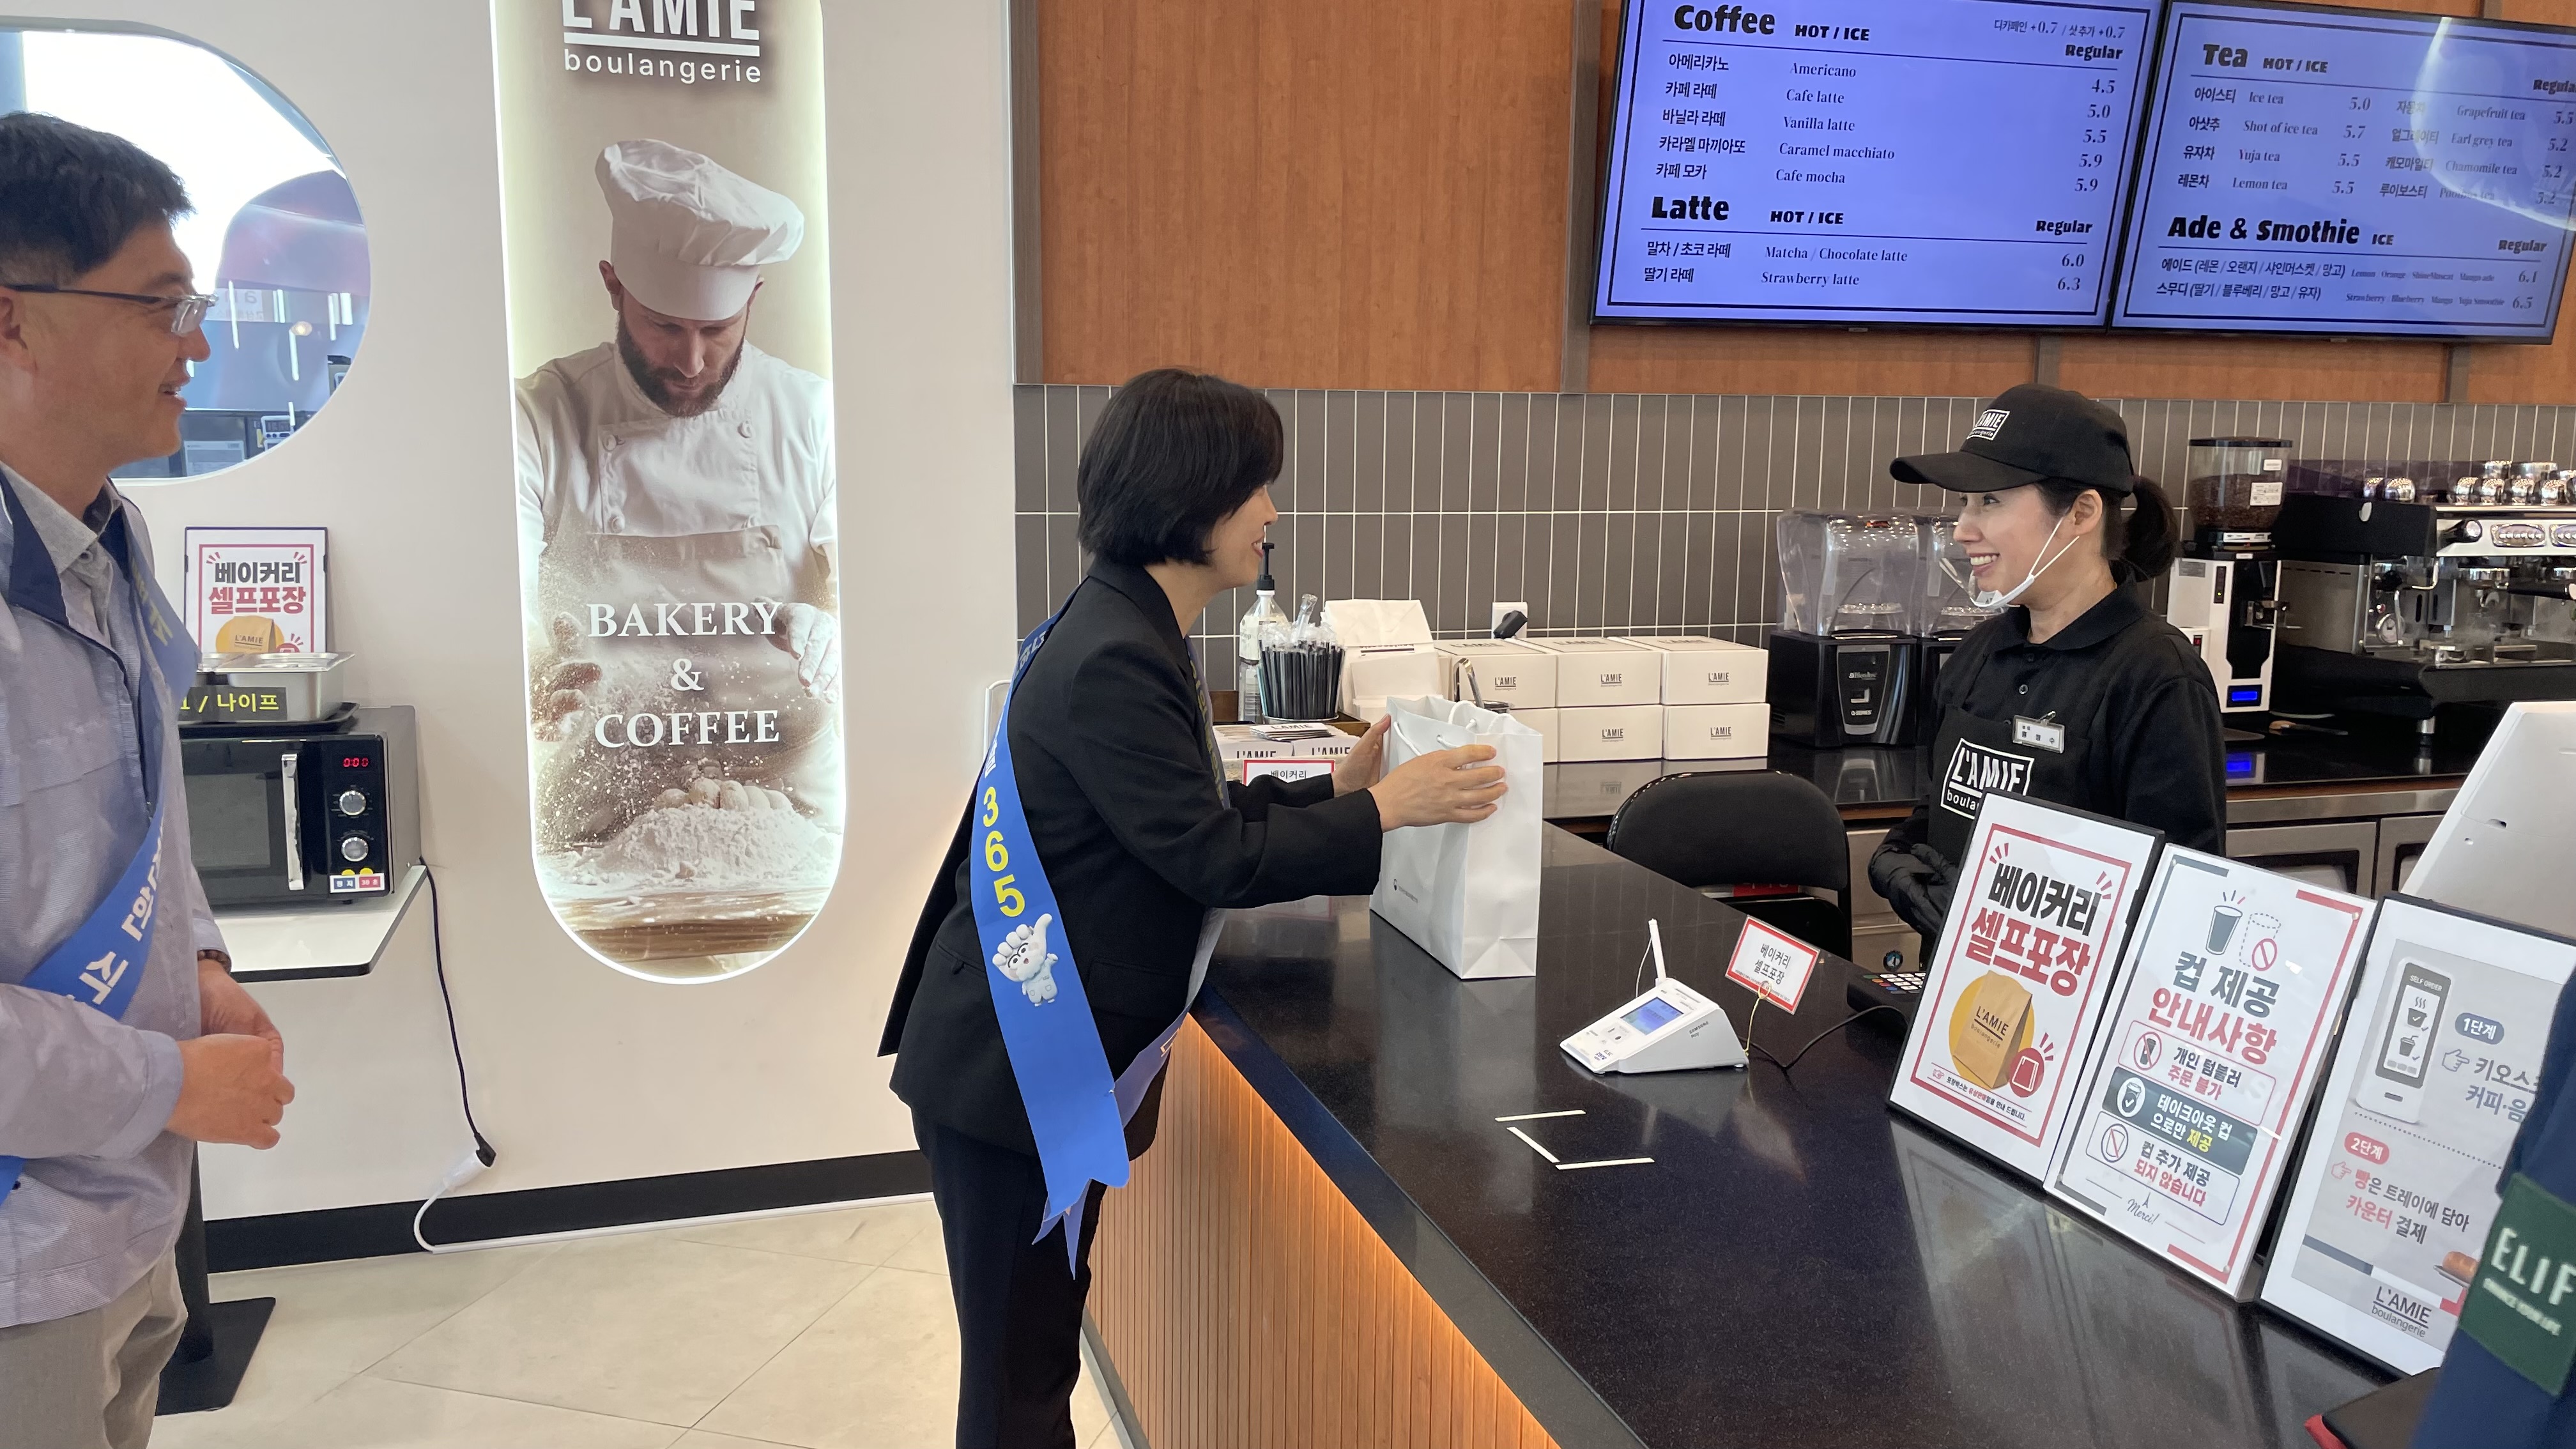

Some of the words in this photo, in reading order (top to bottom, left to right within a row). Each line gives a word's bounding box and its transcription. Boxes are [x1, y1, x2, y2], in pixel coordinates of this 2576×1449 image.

[1674, 4, 1775, 34] Coffee
[1994, 19, 2028, 33] 디카페인
[1795, 24, 1829, 38] HOT
[1844, 28, 1870, 41] ICE
[2066, 44, 2123, 61] Regular
[2203, 44, 2248, 68] Tea
[564, 49, 761, 84] boulangerie
[1669, 54, 1729, 72] 아메리카노
[1790, 63, 1856, 77] Americano
[2263, 57, 2294, 69] HOT
[2305, 61, 2328, 73] ICE
[1666, 82, 1690, 98] 카페
[1694, 84, 1717, 99] 라떼
[2092, 79, 2115, 93] 4.5
[1786, 89, 1814, 103] Cafe
[1817, 90, 1844, 103] latte
[2195, 87, 2236, 103] 아이스티
[2249, 92, 2265, 102] Ice
[2267, 93, 2284, 104] tea
[2087, 104, 2111, 118] 5.0
[2349, 96, 2370, 111] 5.0
[1662, 109, 1699, 125] 바닐라
[1701, 111, 1726, 126] 라떼
[2457, 105, 2508, 120] Grapefruit
[2511, 109, 2525, 120] tea
[2553, 111, 2573, 124] 5.5
[1784, 117, 1823, 130] Vanilla
[1828, 118, 1855, 131] latte
[2189, 116, 2220, 132] 아샷추
[2243, 121, 2267, 132] Shot
[2271, 122, 2282, 133] of
[2284, 123, 2299, 134] ice
[2303, 123, 2318, 135] tea
[2083, 130, 2106, 143] 5.5
[2343, 125, 2366, 139] 5.7
[1659, 137, 1695, 152] 카라멜
[1698, 139, 1745, 154] 마끼아또
[2451, 133, 2471, 144] Earl
[2498, 136, 2513, 147] tea
[2548, 138, 2568, 151] 5.2
[1779, 143, 1830, 157] Caramel
[1833, 147, 1894, 160] macchiato
[2184, 145, 2214, 160] 유자차
[2239, 150, 2261, 163] Yuja
[2264, 150, 2280, 162] tea
[2079, 154, 2102, 167] 5.9
[2338, 153, 2360, 166] 5.5
[1656, 164, 1680, 179] 카페
[1683, 164, 1707, 180] 모카
[2446, 161, 2500, 174] Chamomile
[2503, 164, 2517, 174] tea
[2542, 165, 2563, 178] 5.2
[1776, 169, 1802, 182] Cafe
[1805, 172, 1845, 183] mocha
[2178, 174, 2209, 188] 레몬차
[2075, 178, 2098, 192] 5.9
[2233, 178, 2269, 188] Lemon
[2272, 178, 2287, 190] tea
[2332, 181, 2355, 194] 5.5
[2380, 183, 2428, 198] 루이보스티
[1652, 195, 1729, 220] Latte
[1770, 211, 1804, 223] HOT
[1818, 212, 1844, 224] ICE
[2036, 220, 2092, 235] Regular
[2168, 215, 2221, 239] Ade
[2230, 218, 2247, 239] &
[2257, 218, 2359, 244] Smothie
[2372, 234, 2394, 245] ICE
[2498, 240, 2547, 254] Regular
[1647, 241, 1671, 257] 말차
[1680, 242, 1705, 256] 초코
[1707, 243, 1731, 258] 라떼
[1766, 247, 1807, 259] Matcha
[1820, 248, 1878, 261] Chocolate
[1881, 250, 1908, 262] latte
[2062, 254, 2084, 266] 6.0
[2162, 258, 2193, 273] 에이드
[1644, 267, 1667, 281] 딸기
[1671, 268, 1694, 282] 라떼
[1761, 272, 1829, 287] Strawberry
[1832, 273, 1860, 285] latte
[2518, 270, 2538, 283] 6.1
[2058, 277, 2080, 291] 6.3
[2156, 282, 2188, 296] 스무디
[2223, 284, 2264, 298] 블루베리
[2271, 286, 2289, 298] 망고
[2513, 296, 2533, 309] 6.5
[215, 562, 300, 583] 베이커리
[209, 586, 306, 615] 셀프포장
[586, 602, 783, 637] BAKERY
[235, 634, 263, 644] L'AMIE
[670, 658, 705, 691] &
[1495, 677, 1516, 686] L'AMIE
[1601, 673, 1621, 682] L'AMIE
[1708, 673, 1729, 681] L'AMIE
[217, 693, 279, 712] 나이프
[594, 710, 779, 748] COFFEE
[1602, 728, 1623, 737] L'AMIE
[1710, 726, 1731, 735] L'AMIE
[343, 758, 369, 767] 0:00
[1271, 770, 1307, 779] 베이커리
[983, 786, 1025, 917] 365
[1988, 862, 2102, 936] 베이커리
[1761, 944, 1791, 969] 베이커리
[1965, 907, 2091, 997] 셀프포장
[1754, 960, 1784, 985] 셀프포장
[2174, 951, 2207, 992] 컵
[2210, 965, 2280, 1018] 제공
[2410, 976, 2423, 984] SELF
[2424, 981, 2442, 991] ORDER
[1976, 1006, 2009, 1036] L'AMIE
[2149, 988, 2277, 1064] 안내사항
[2464, 1018, 2497, 1040] 1단계
[2174, 1047, 2200, 1070] 개인
[2202, 1059, 2242, 1087] 텀블러
[2168, 1064, 2194, 1087] 주문
[2195, 1077, 2222, 1100] 불가
[2158, 1094, 2217, 1134] 테이크아웃
[2218, 1121, 2233, 1141] 컵
[2150, 1113, 2186, 1140] 으로만
[2186, 1128, 2213, 1153] 제공
[2351, 1138, 2384, 1160] 2단계
[2141, 1141, 2154, 1159] 컵
[2156, 1149, 2181, 1173] 추가
[2183, 1162, 2210, 1186] 제공
[2135, 1159, 2158, 1182] 되지
[2159, 1172, 2206, 1207] 않습니다
[2355, 1169, 2382, 1195] 빵은
[2383, 1184, 2439, 1220] 트레이에
[2441, 1207, 2469, 1232] 담아
[2127, 1199, 2159, 1225] Merci!
[2346, 1195, 2393, 1229] 카운터
[2396, 1216, 2427, 1245] 결제
[2376, 1286, 2432, 1324] L'AMIE
[2372, 1305, 2426, 1338] boulangerie
